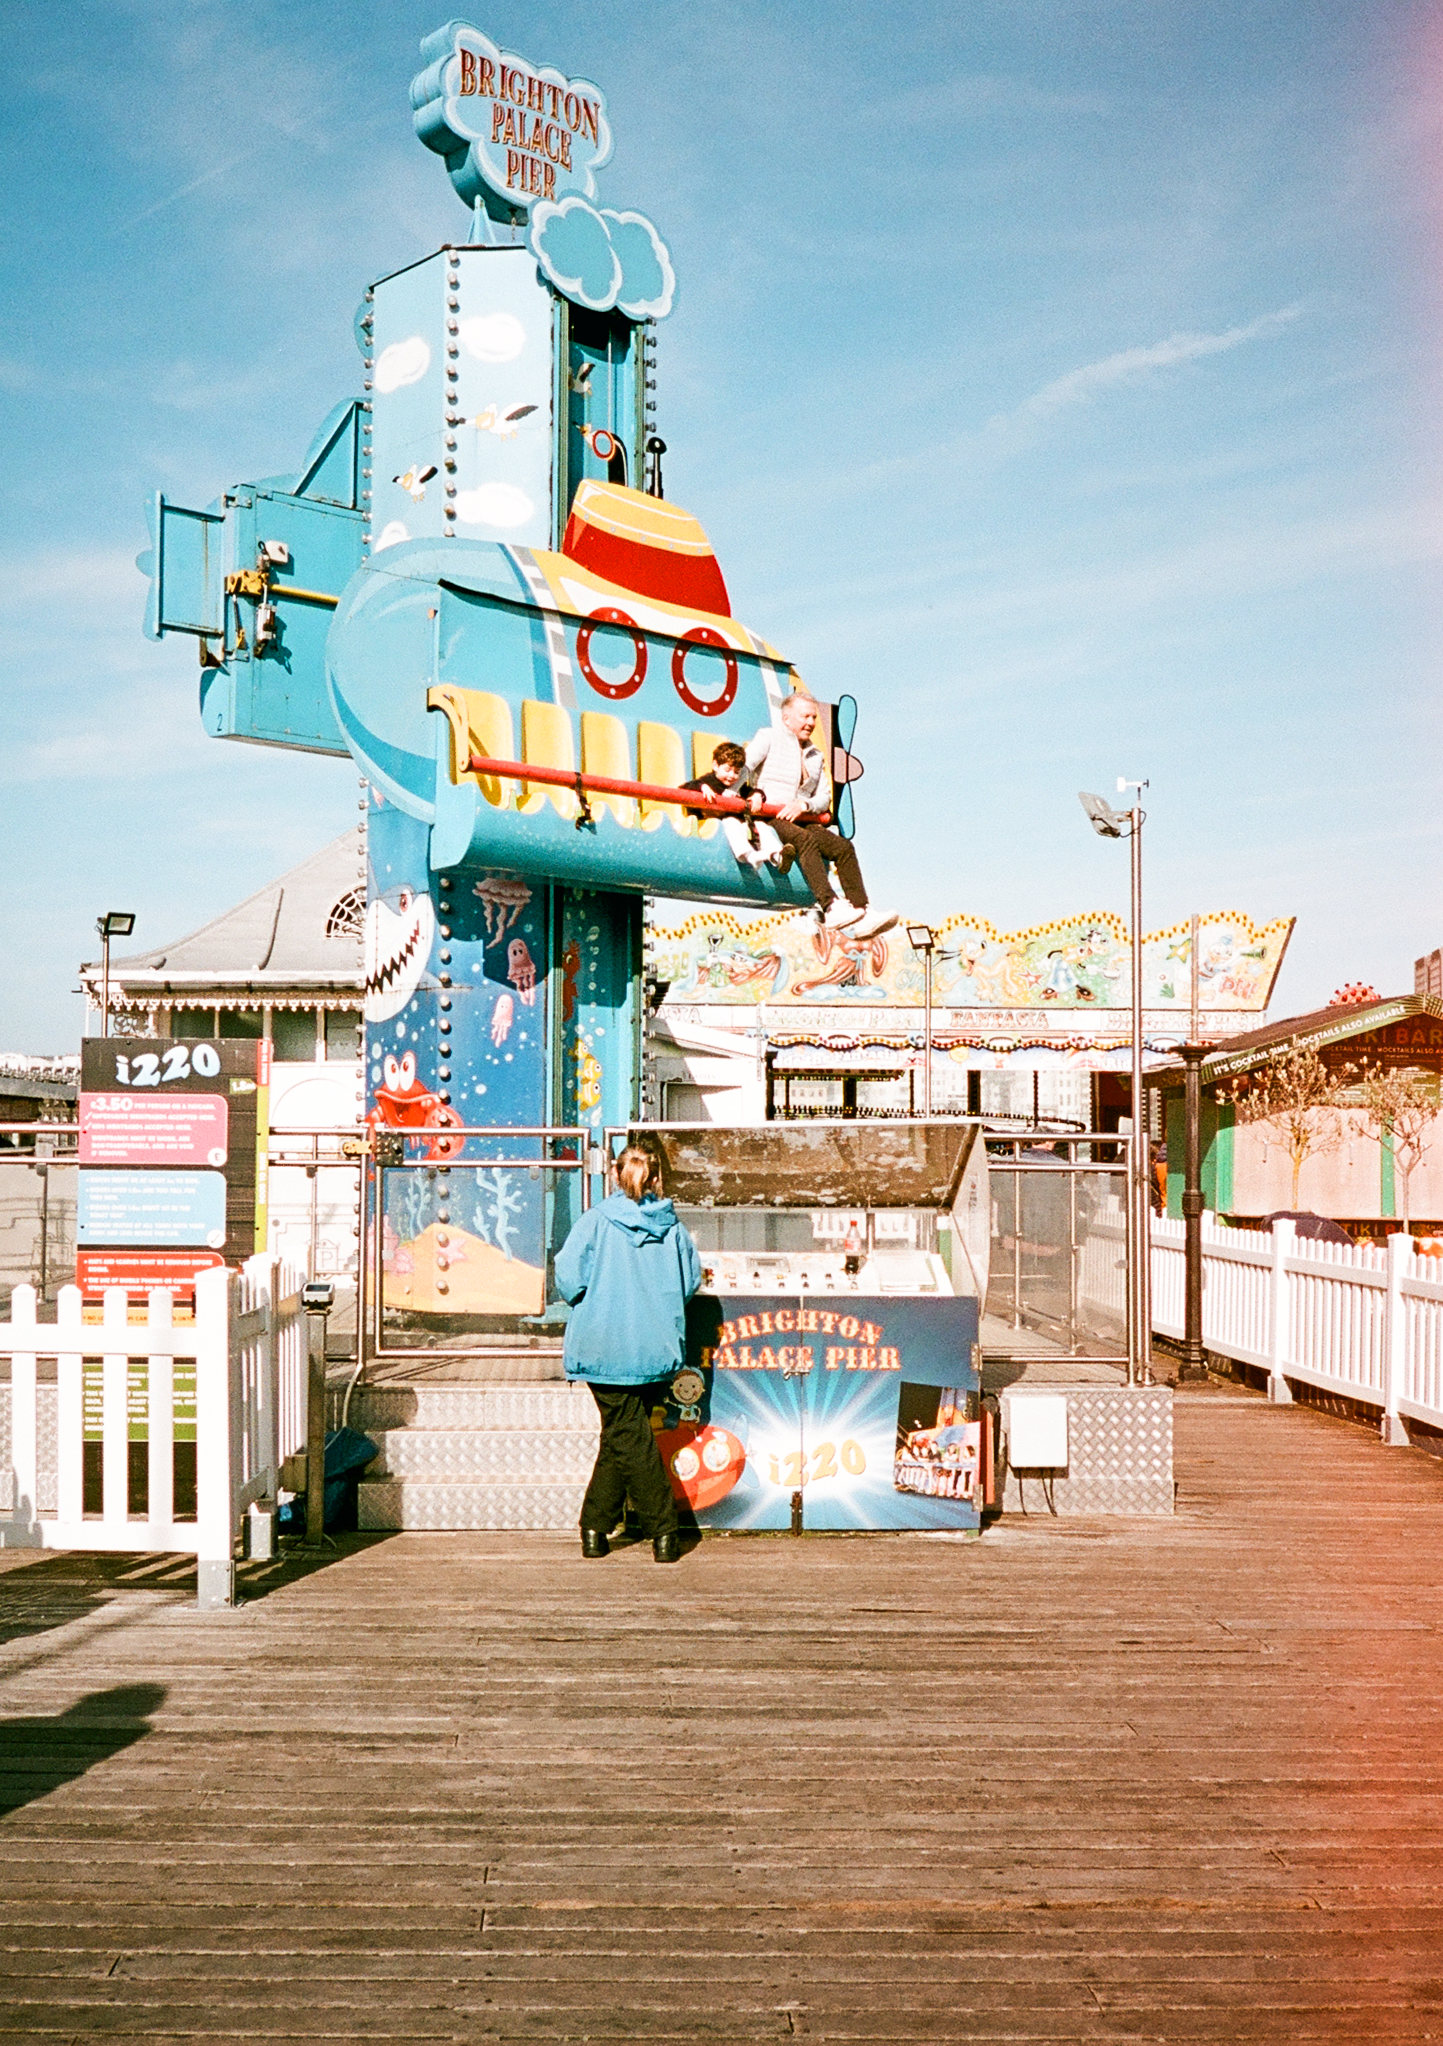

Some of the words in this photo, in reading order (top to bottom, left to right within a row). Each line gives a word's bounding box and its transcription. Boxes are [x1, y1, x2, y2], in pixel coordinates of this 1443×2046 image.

[459, 47, 601, 149] BRIGHTON
[490, 102, 573, 173] PALACE
[505, 149, 557, 201] PIER
[950, 1011, 1050, 1029] FANTASIA
[1106, 1012, 1213, 1030] BRGHTON
[1213, 1064, 1230, 1076] IT'S
[1229, 1050, 1270, 1070] COCKTAIL
[1341, 1019, 1363, 1033] ALSO
[1364, 1005, 1406, 1025] AVAILABLE
[1396, 1028, 1442, 1044] BAR
[115, 1043, 221, 1086] i220
[716, 1309, 884, 1347] BRIGHTON
[701, 1346, 813, 1370] PALACE
[825, 1346, 901, 1371] PIER
[768, 1439, 867, 1487] i220
